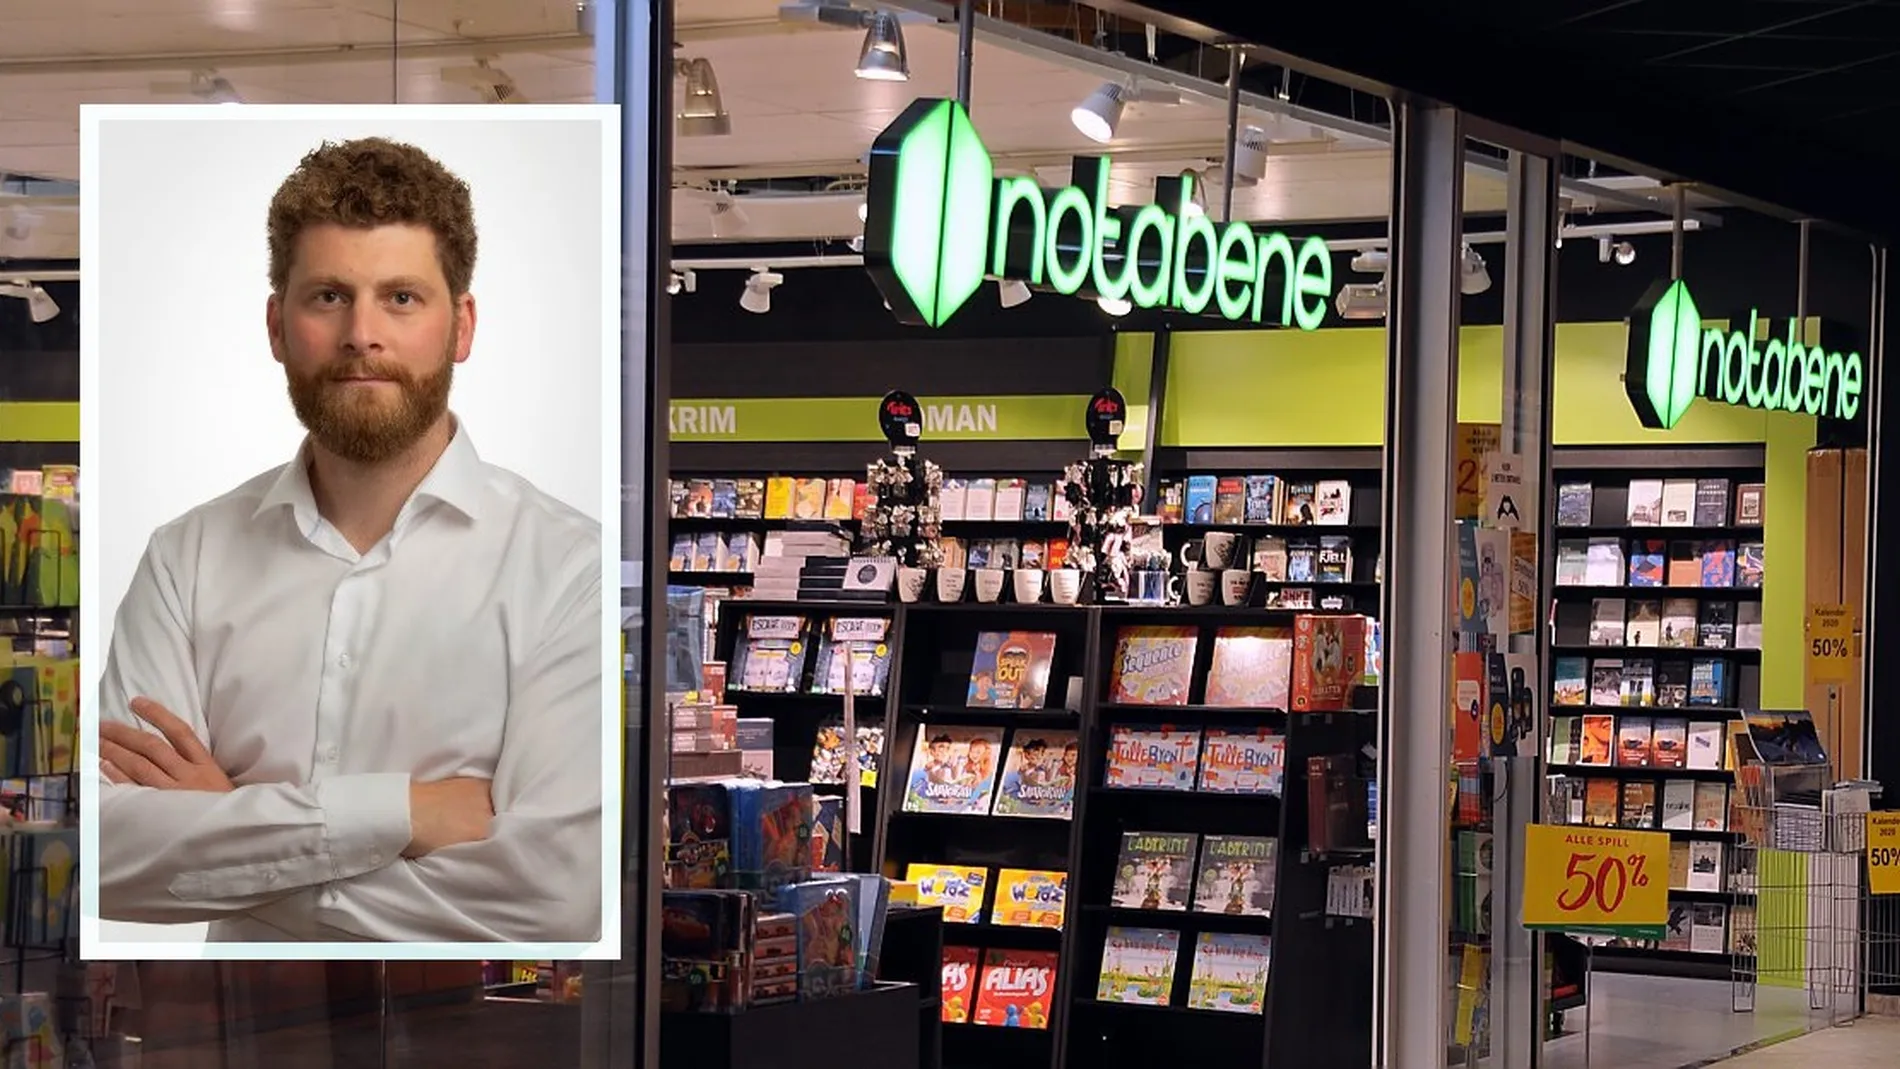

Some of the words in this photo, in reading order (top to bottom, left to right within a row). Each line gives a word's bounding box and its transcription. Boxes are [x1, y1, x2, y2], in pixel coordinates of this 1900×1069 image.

[994, 155, 1332, 330] notabene
[1700, 308, 1862, 420] notabene
[921, 404, 997, 432] MAN
[1812, 638, 1848, 657] 50%
[1566, 834, 1593, 846] ALLE
[1598, 837, 1630, 848] SPILL
[1557, 853, 1650, 913] 50%
[985, 967, 1050, 996] ALIAS
